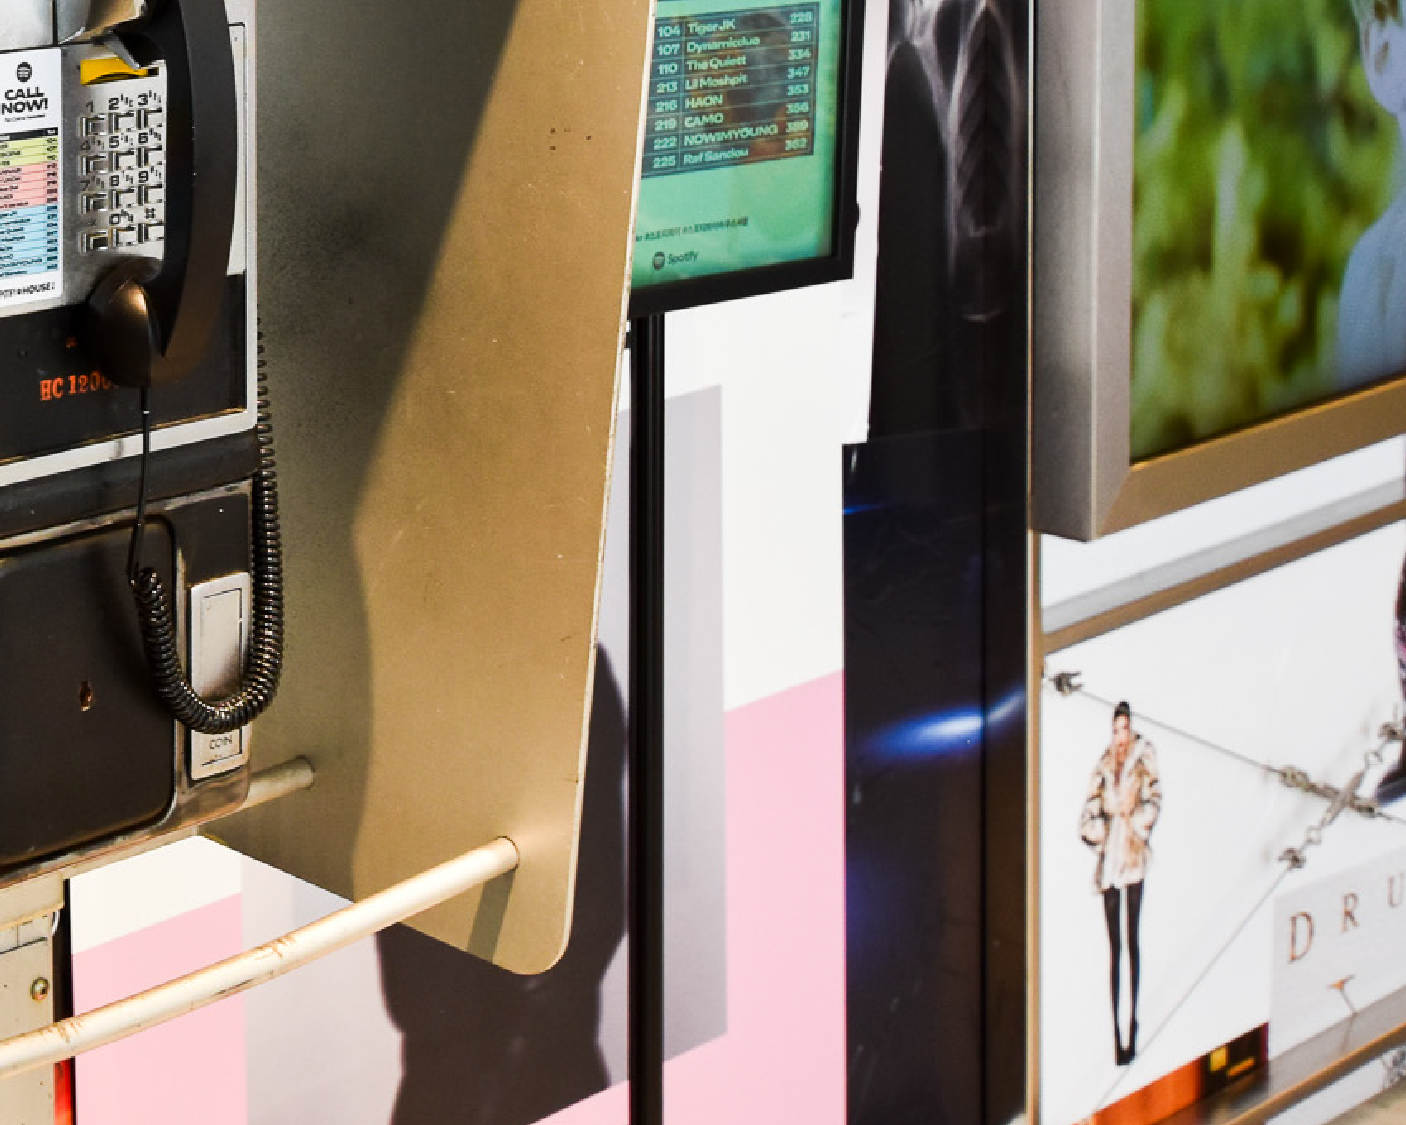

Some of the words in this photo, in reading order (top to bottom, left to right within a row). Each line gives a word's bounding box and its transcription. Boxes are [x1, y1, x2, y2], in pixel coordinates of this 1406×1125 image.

[658, 25, 681, 37] 104
[688, 21, 718, 35] Tiger
[718, 18, 736, 30] JK
[657, 43, 680, 55] 107
[658, 62, 678, 74] 110
[686, 59, 709, 70] The
[4, 86, 46, 100] CALL
[685, 93, 723, 108] HAON
[0, 97, 49, 115] NOW!
[108, 97, 120, 111] 2
[138, 93, 148, 106] 3
[684, 112, 724, 128] CAMO
[109, 135, 120, 149] 5
[138, 132, 149, 144] 6
[110, 174, 120, 187] 8
[138, 171, 149, 183] 9
[40, 377, 65, 401] HC
[209, 736, 232, 750] COIN
